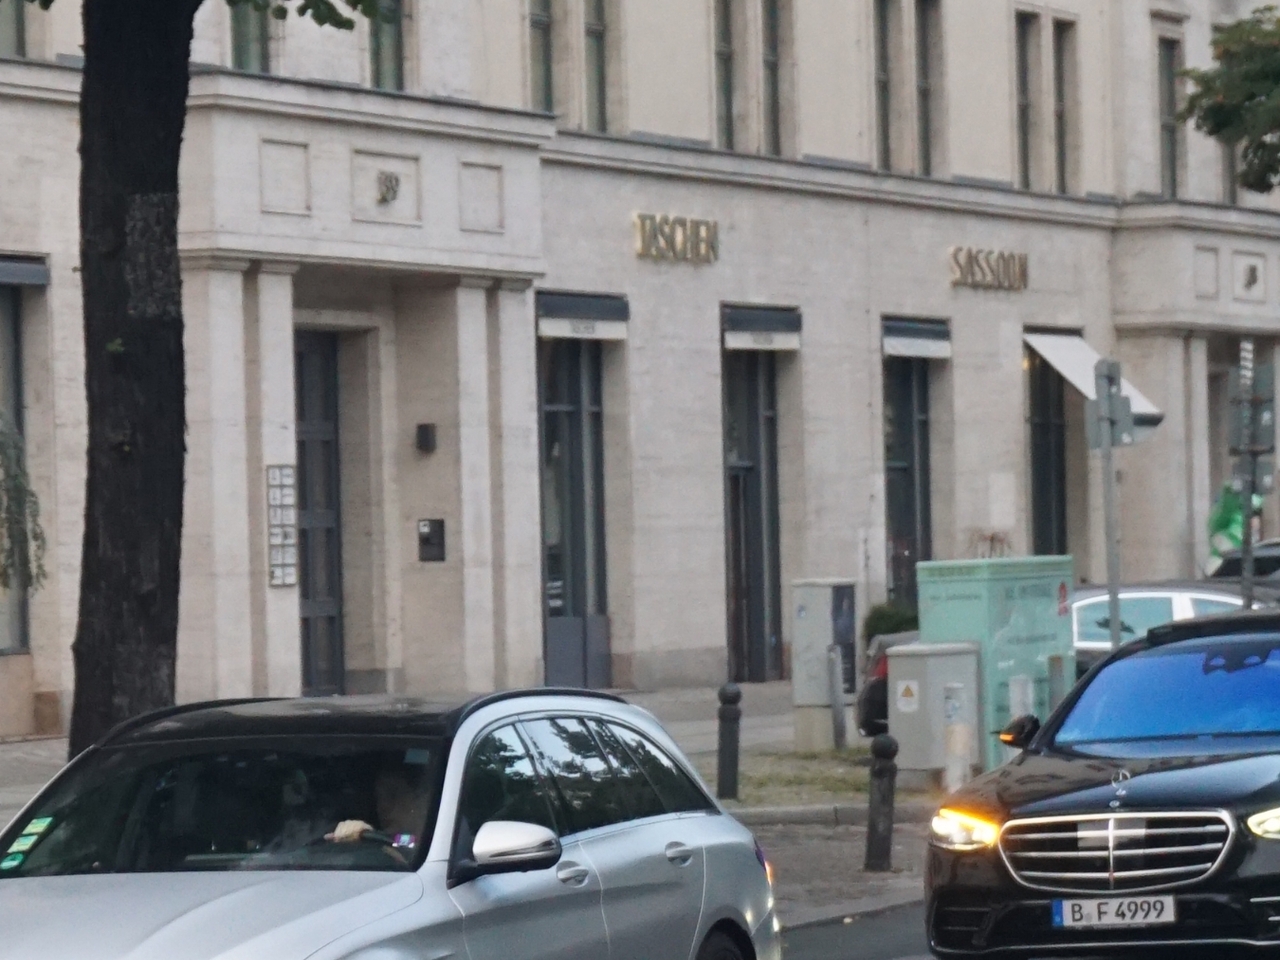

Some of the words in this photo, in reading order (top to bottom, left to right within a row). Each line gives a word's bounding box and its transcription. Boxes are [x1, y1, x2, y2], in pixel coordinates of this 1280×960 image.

[635, 212, 719, 263] TASCHEN
[949, 246, 1028, 292] SASSOON
[1070, 903, 1084, 922] B
[1097, 902, 1109, 921] F
[1114, 900, 1165, 920] 4999
